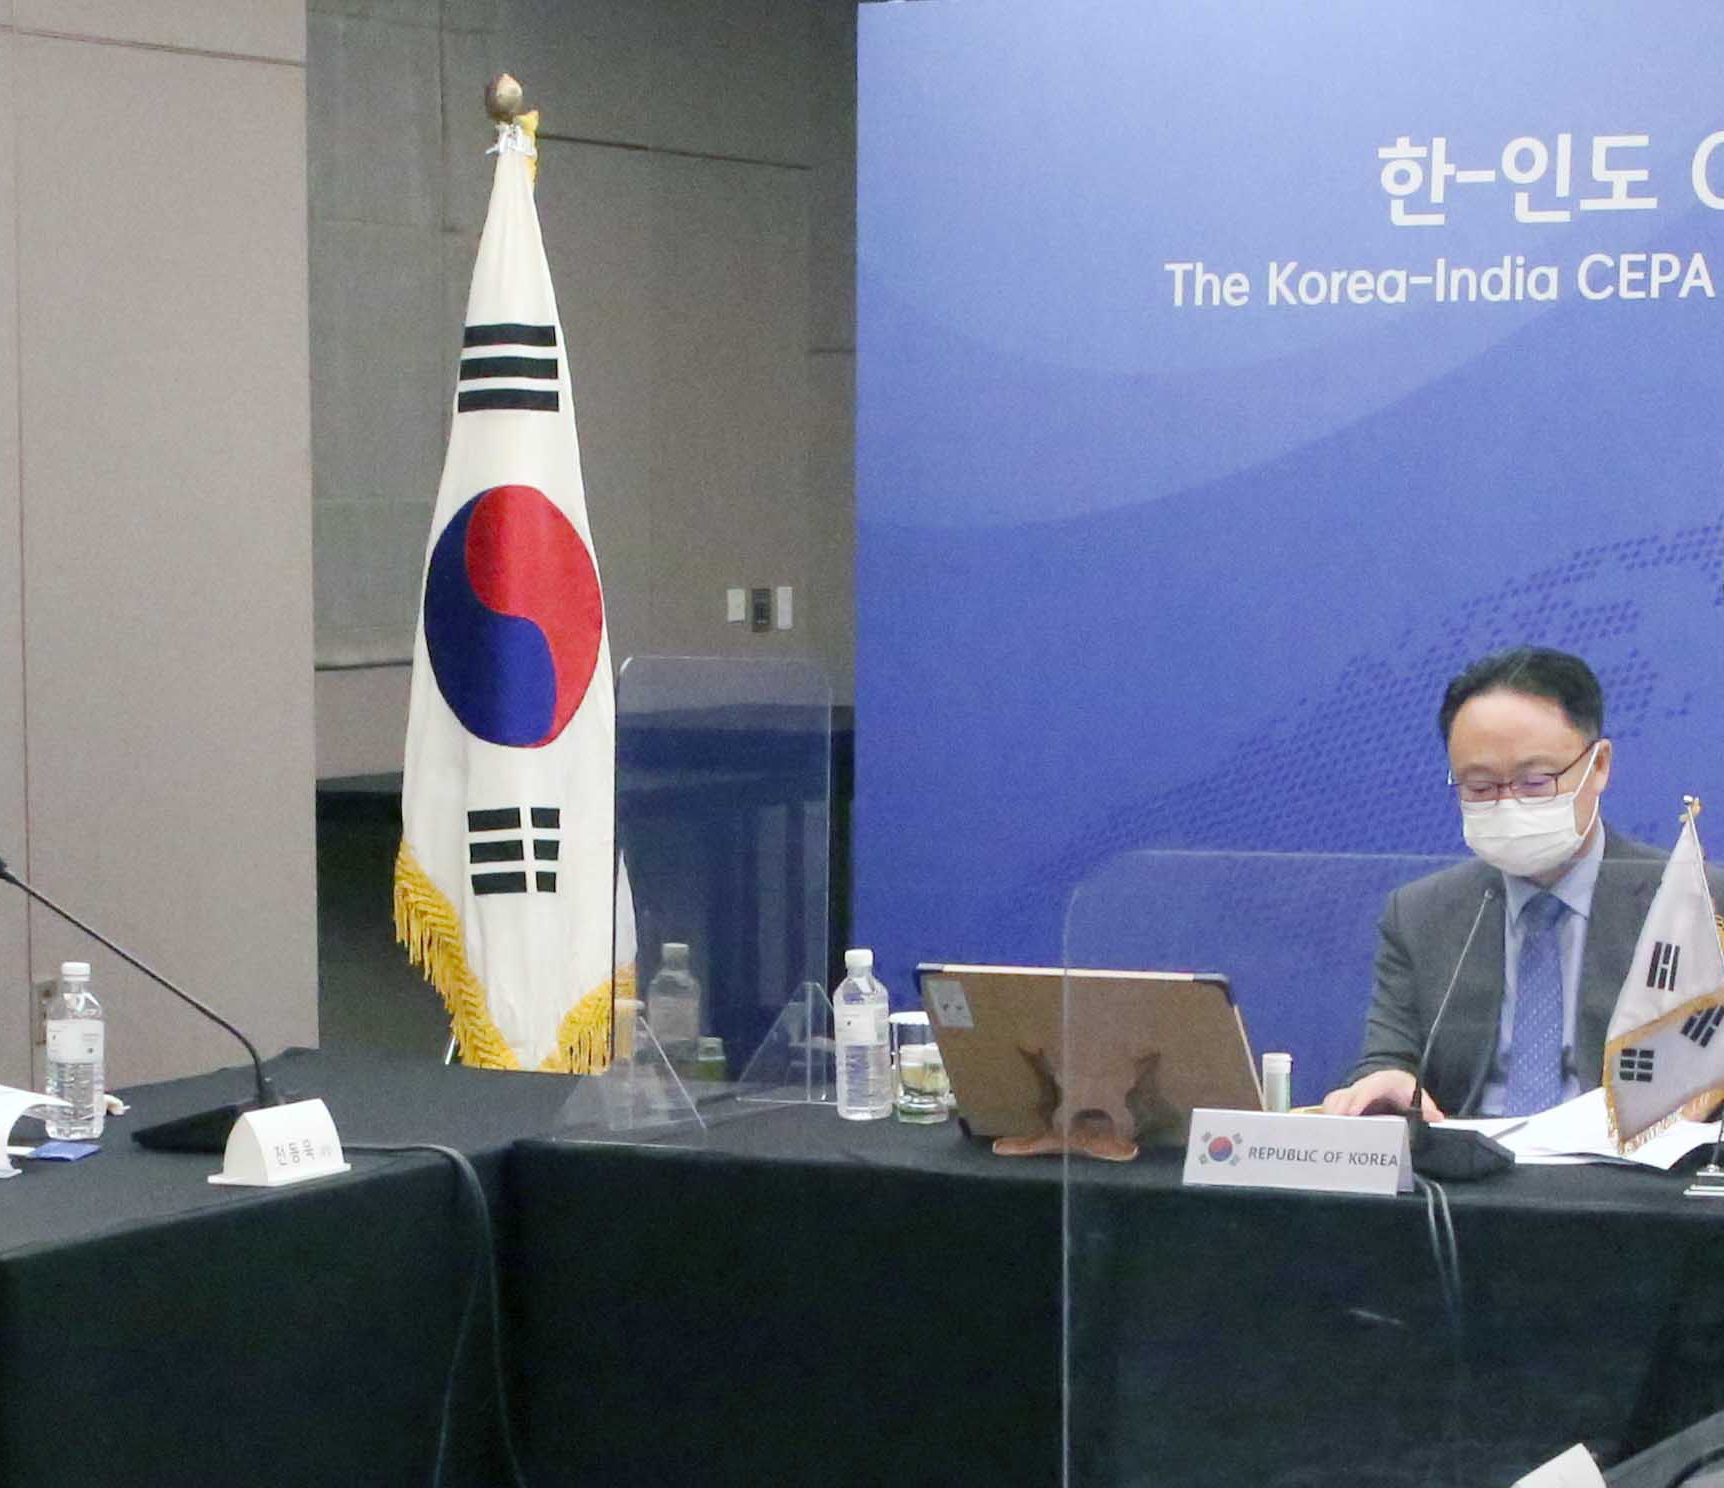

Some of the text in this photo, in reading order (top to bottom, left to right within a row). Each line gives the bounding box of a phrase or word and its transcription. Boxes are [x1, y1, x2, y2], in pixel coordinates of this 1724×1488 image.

[1377, 130, 1658, 226] 한-인도
[1163, 261, 1251, 307] The
[1267, 254, 1558, 306] Korea-India
[1578, 252, 1715, 299] CEPA
[1247, 1146, 1399, 1167] REPUBLIC OF KOREA
